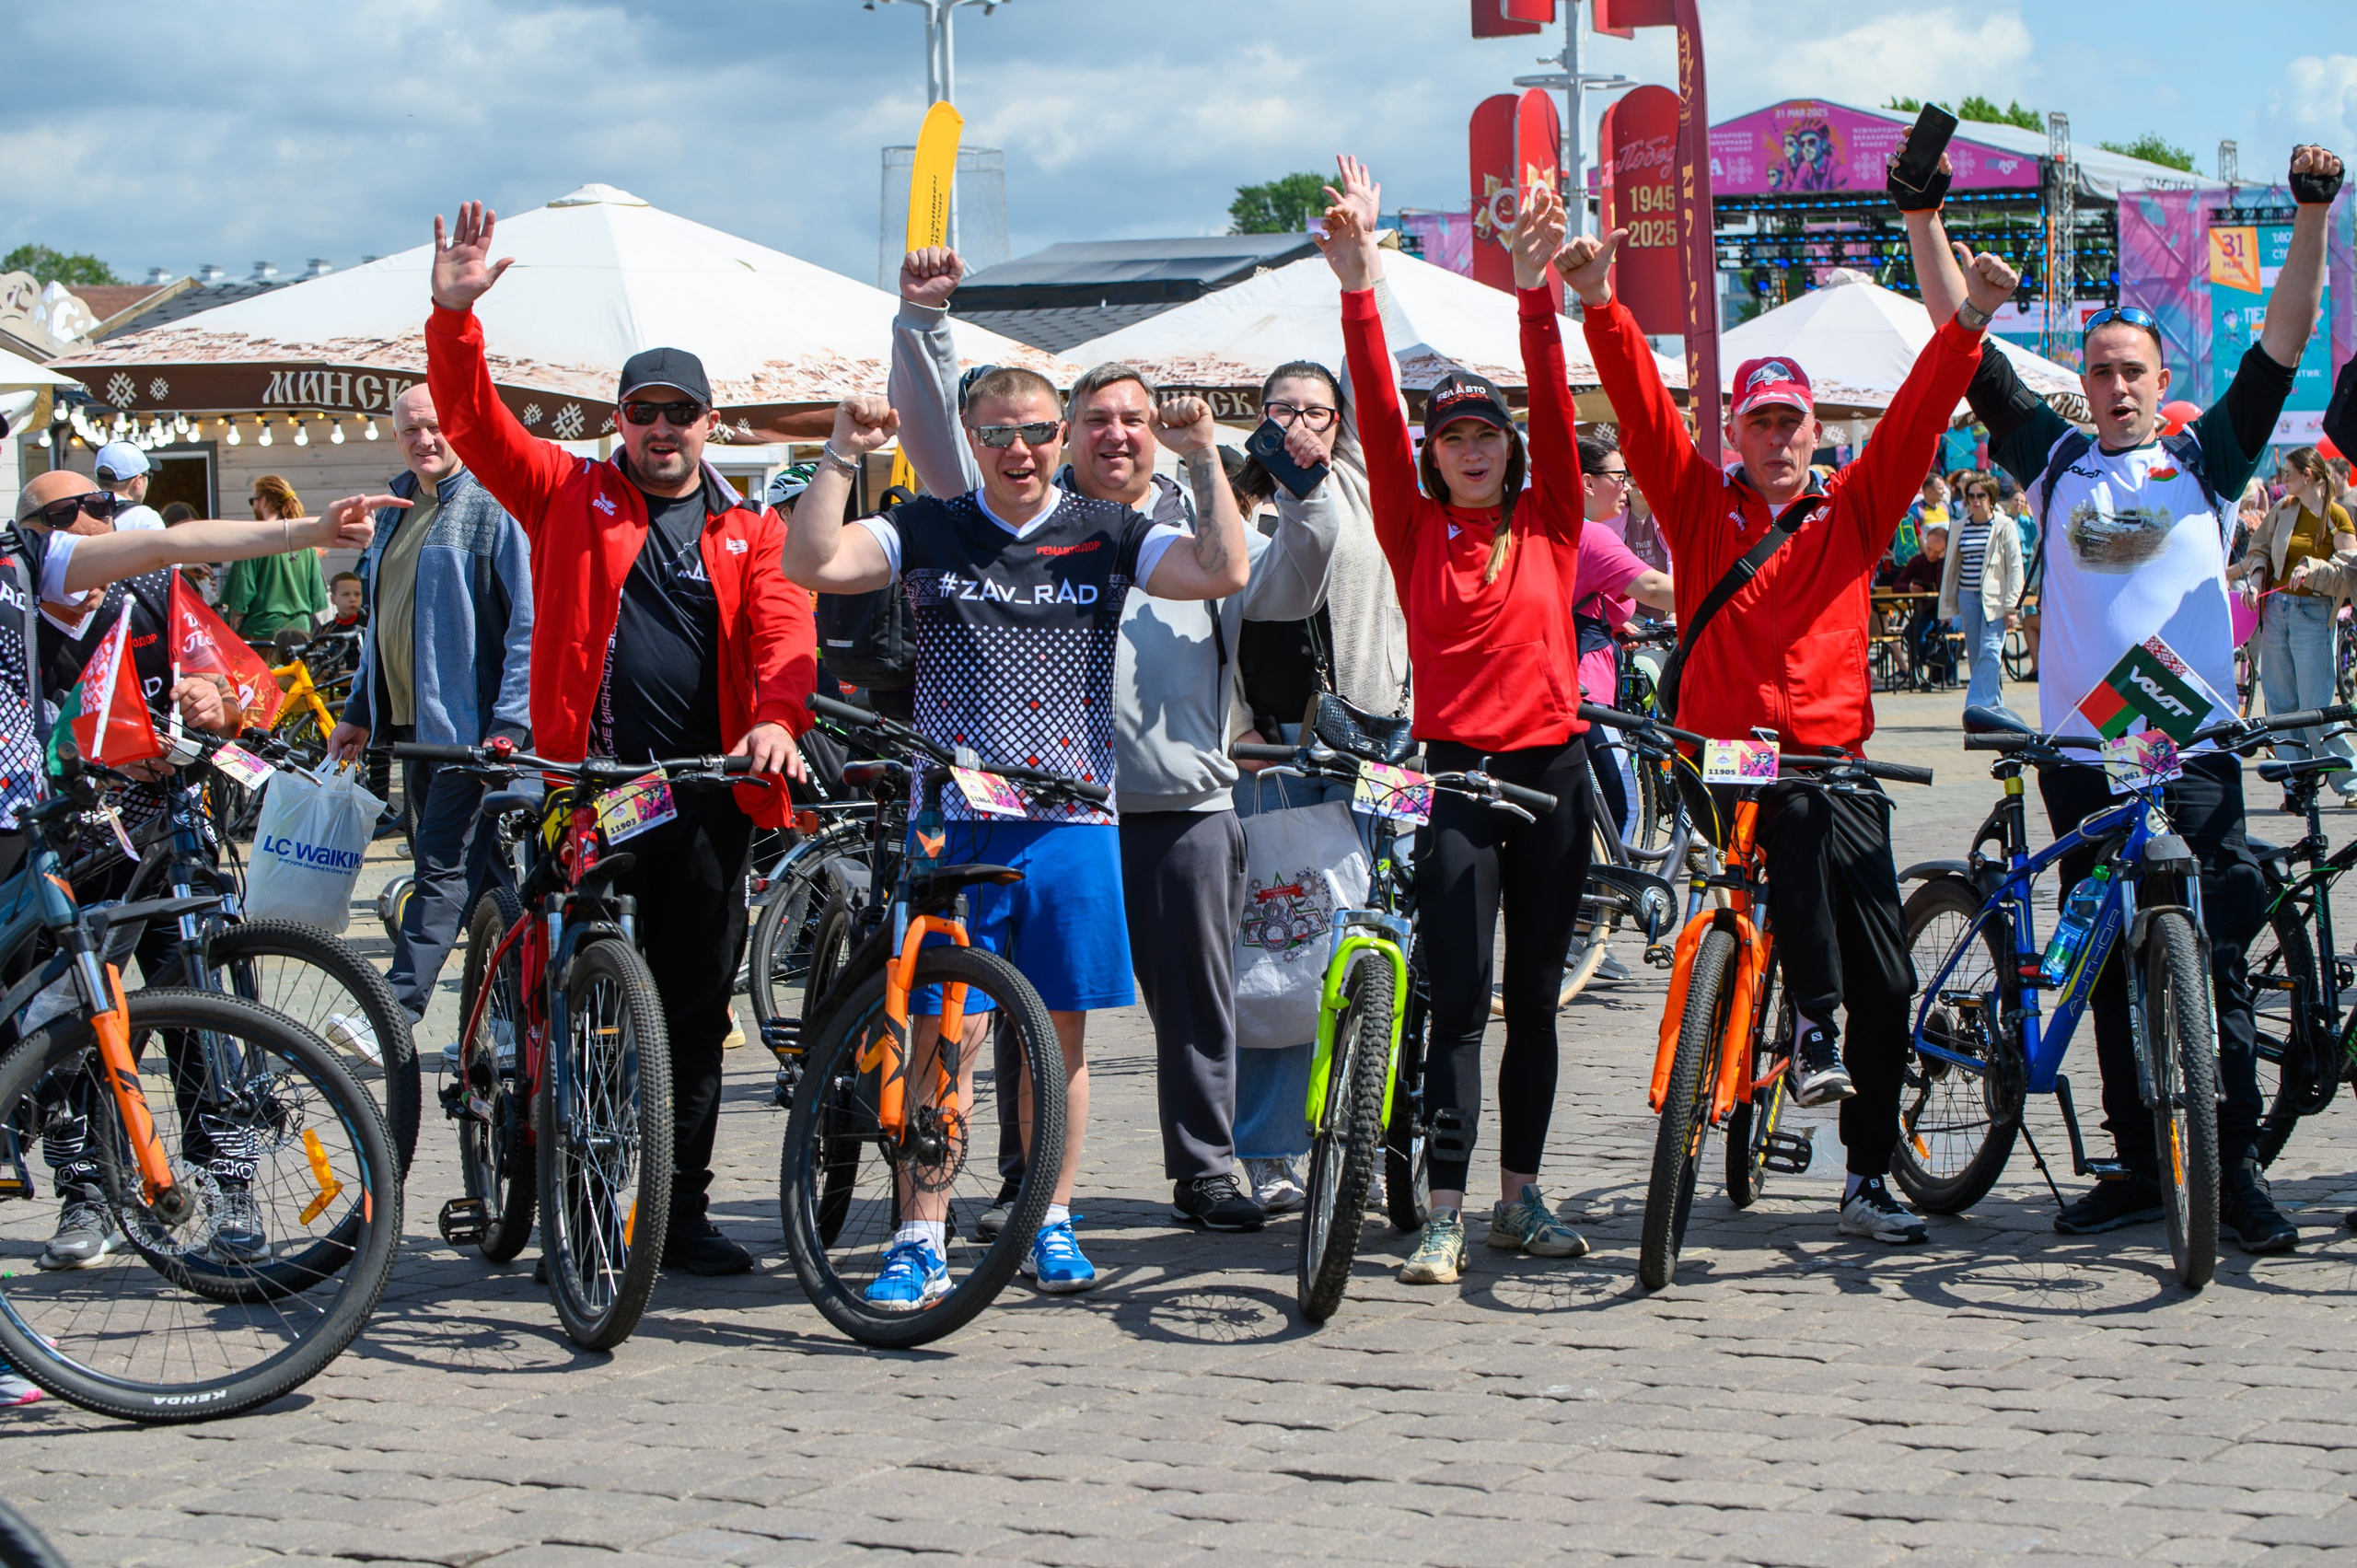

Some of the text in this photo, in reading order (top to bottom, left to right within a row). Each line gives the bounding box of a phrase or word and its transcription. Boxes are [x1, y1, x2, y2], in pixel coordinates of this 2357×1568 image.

[1629, 185, 1676, 213] 1945
[1628, 220, 1678, 249] 2025
[2222, 233, 2245, 258] 31
[610, 818, 637, 834] 11903
[262, 835, 292, 856] LC
[153, 1389, 227, 1406] KENDA
